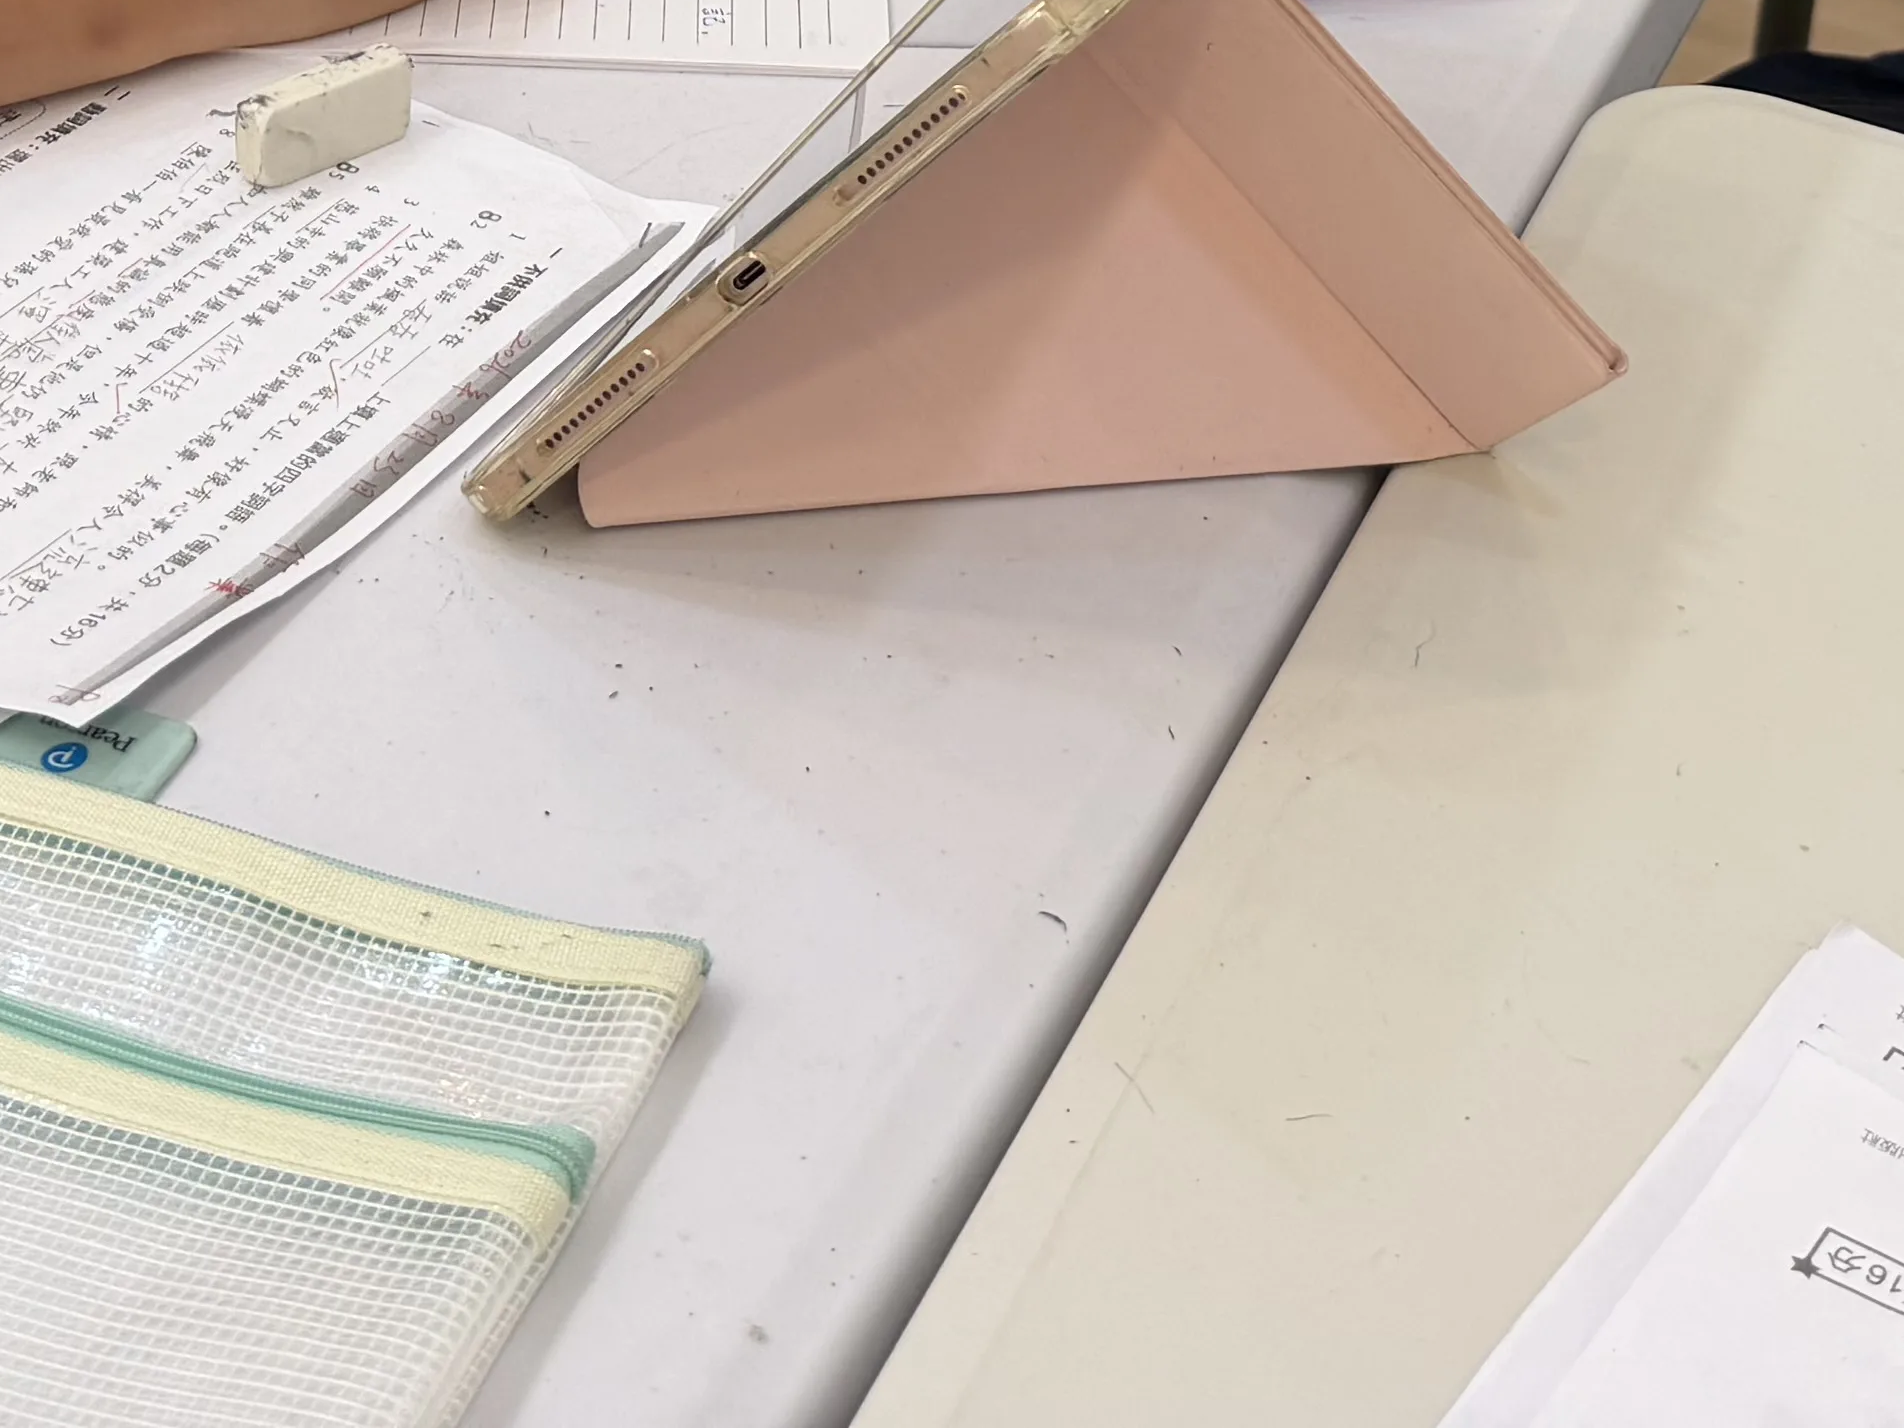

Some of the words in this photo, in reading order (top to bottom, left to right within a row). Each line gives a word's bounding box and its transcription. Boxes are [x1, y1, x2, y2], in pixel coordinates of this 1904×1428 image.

[58, 181, 275, 323] 如人人都能用真誠的態度
[38, 715, 140, 754] Pearon
